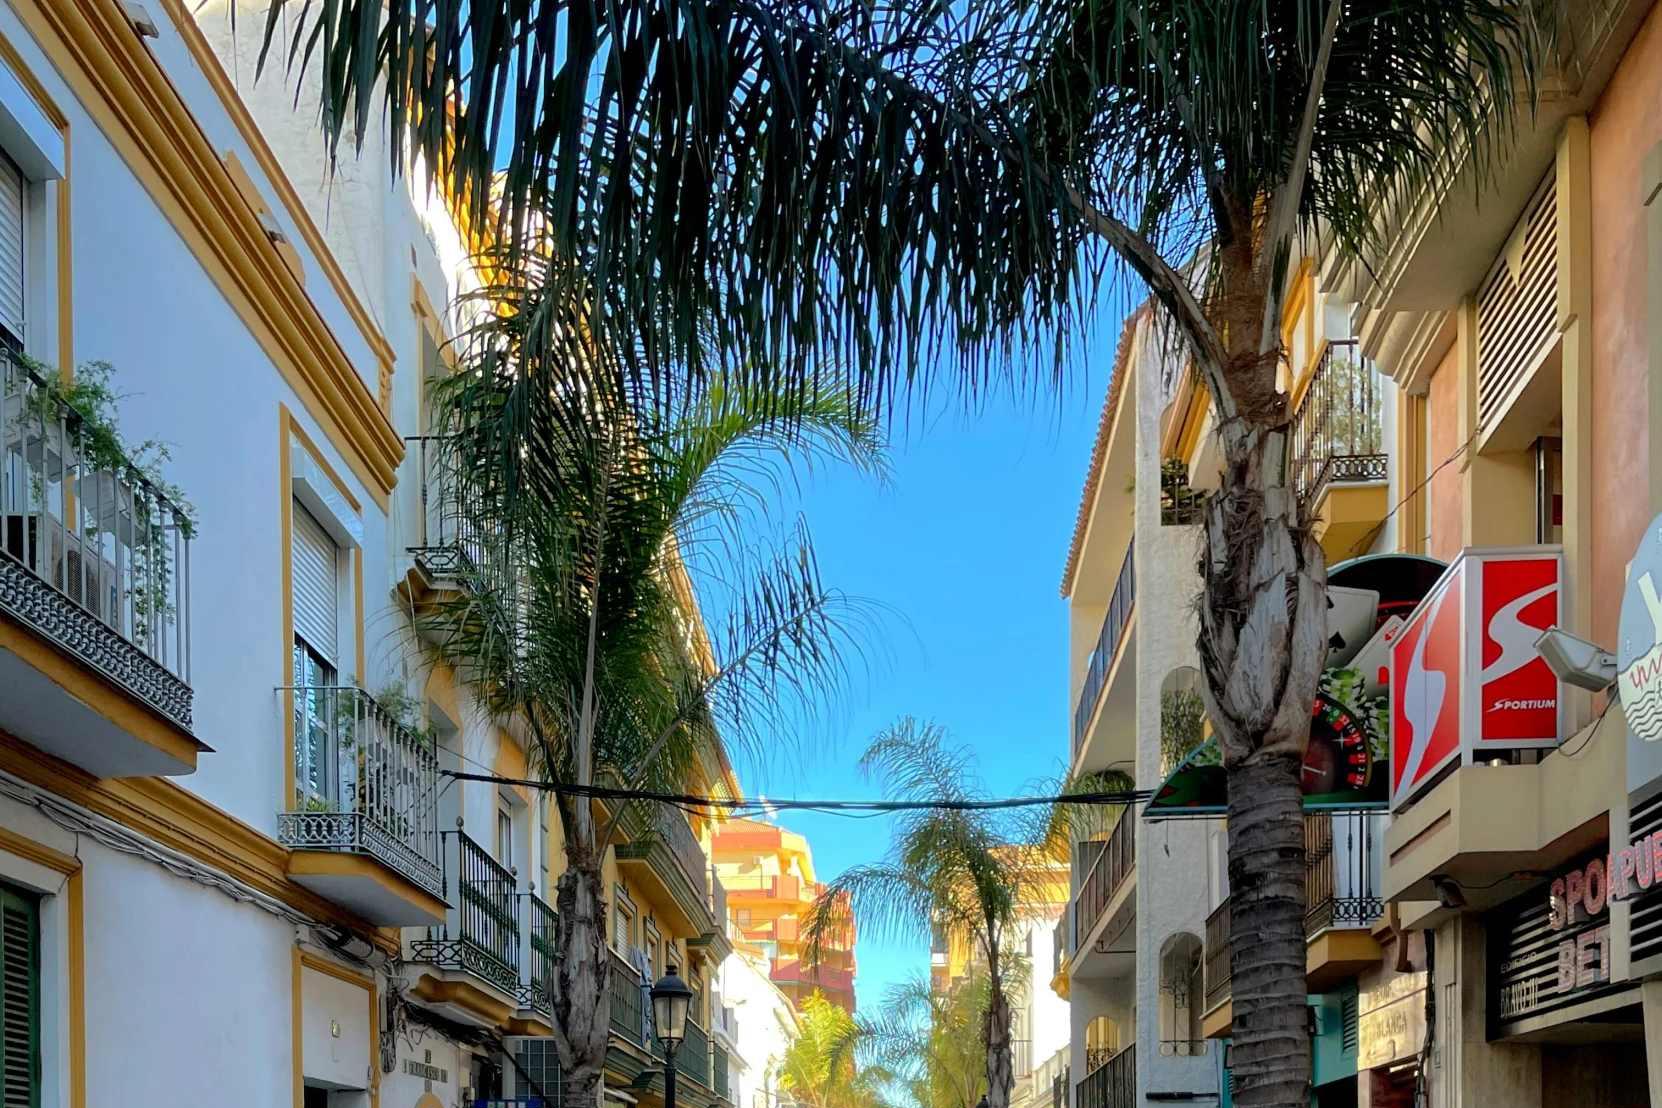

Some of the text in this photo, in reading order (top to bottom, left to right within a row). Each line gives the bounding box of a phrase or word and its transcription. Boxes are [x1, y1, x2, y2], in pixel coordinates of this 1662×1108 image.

[1486, 698, 1556, 712] SPORTIUM
[1322, 704, 1332, 712] 26
[1333, 709, 1340, 717] 0
[1347, 724, 1357, 733] 15
[1357, 753, 1366, 763] 21
[1501, 952, 1537, 974] EDIFICIO
[1557, 924, 1610, 994] BET
[1501, 980, 1527, 1018] BRAVO
[1376, 1011, 1407, 1039] BLANCA
